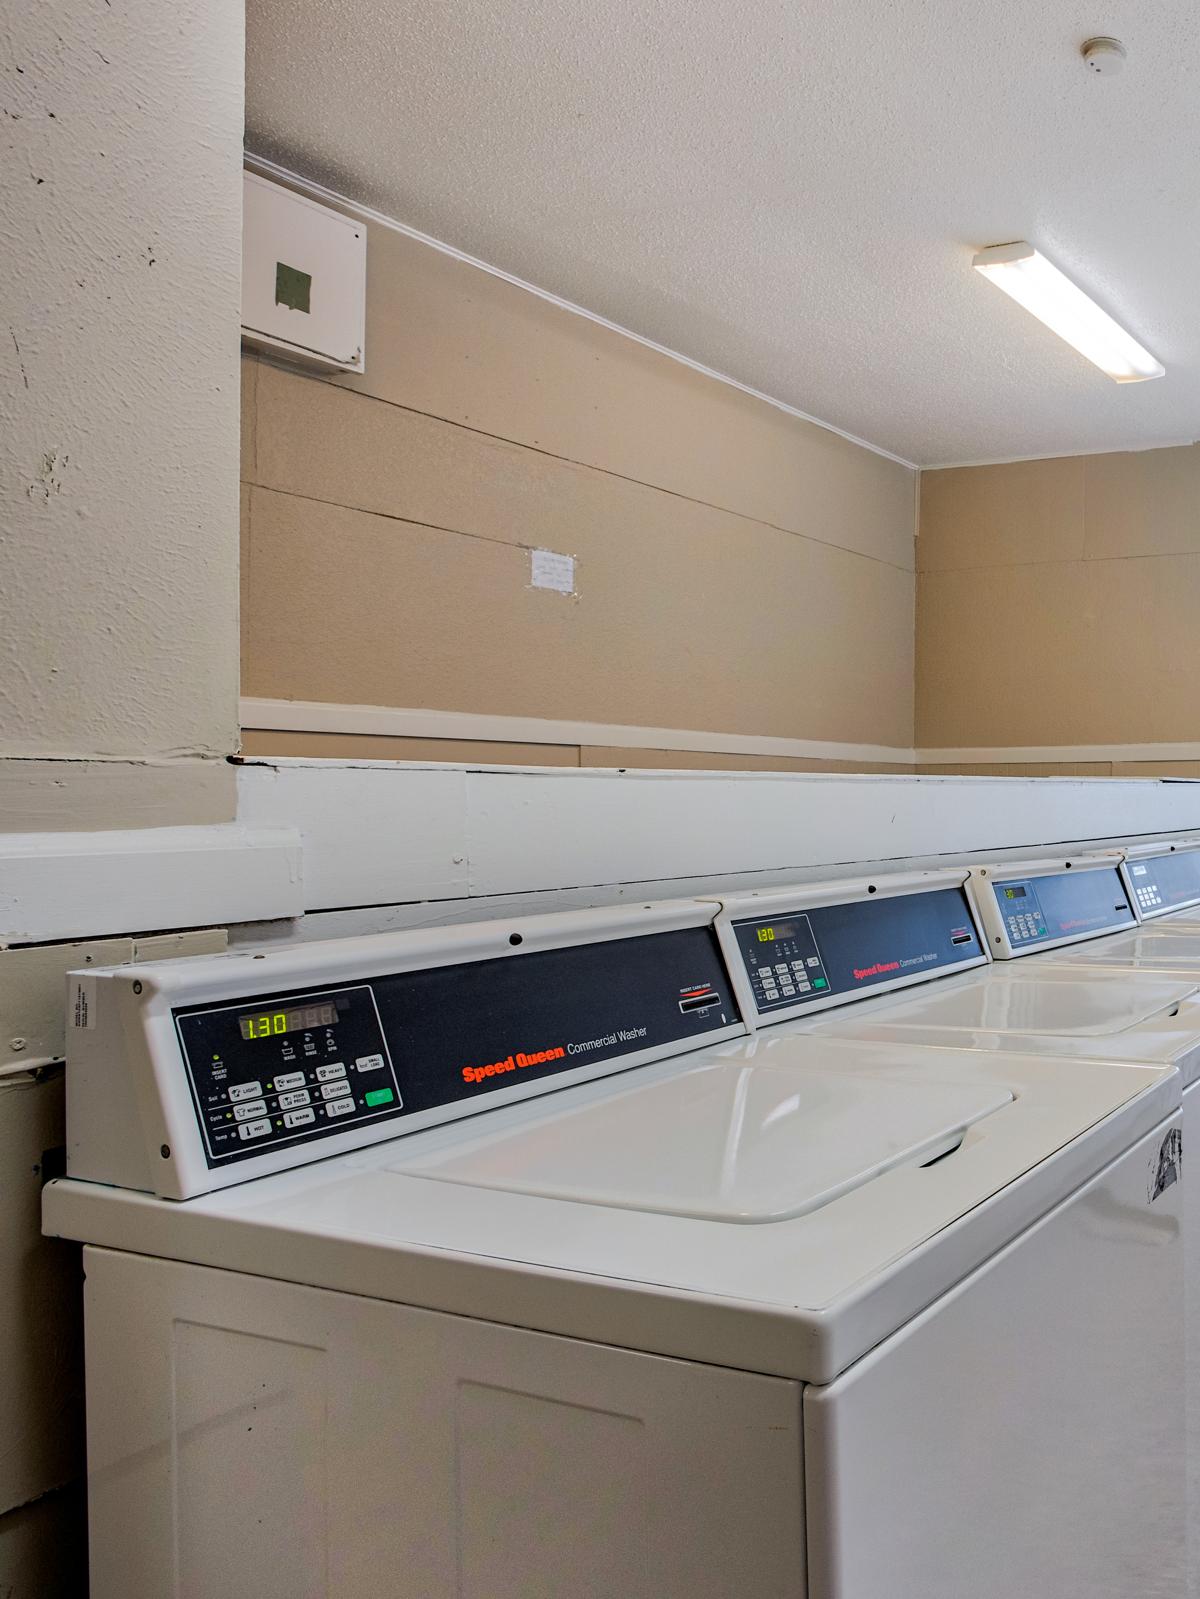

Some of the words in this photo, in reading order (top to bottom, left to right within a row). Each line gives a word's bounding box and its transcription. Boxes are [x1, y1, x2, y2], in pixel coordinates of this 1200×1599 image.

[853, 965, 877, 980] Speed
[876, 961, 900, 973] Queen
[462, 1056, 516, 1083] Speed
[515, 1046, 565, 1068] Queen
[567, 1032, 617, 1055] Commercial
[617, 1026, 647, 1042] Washer
[211, 1068, 228, 1076] INSERT
[242, 1086, 258, 1094] LIGHT
